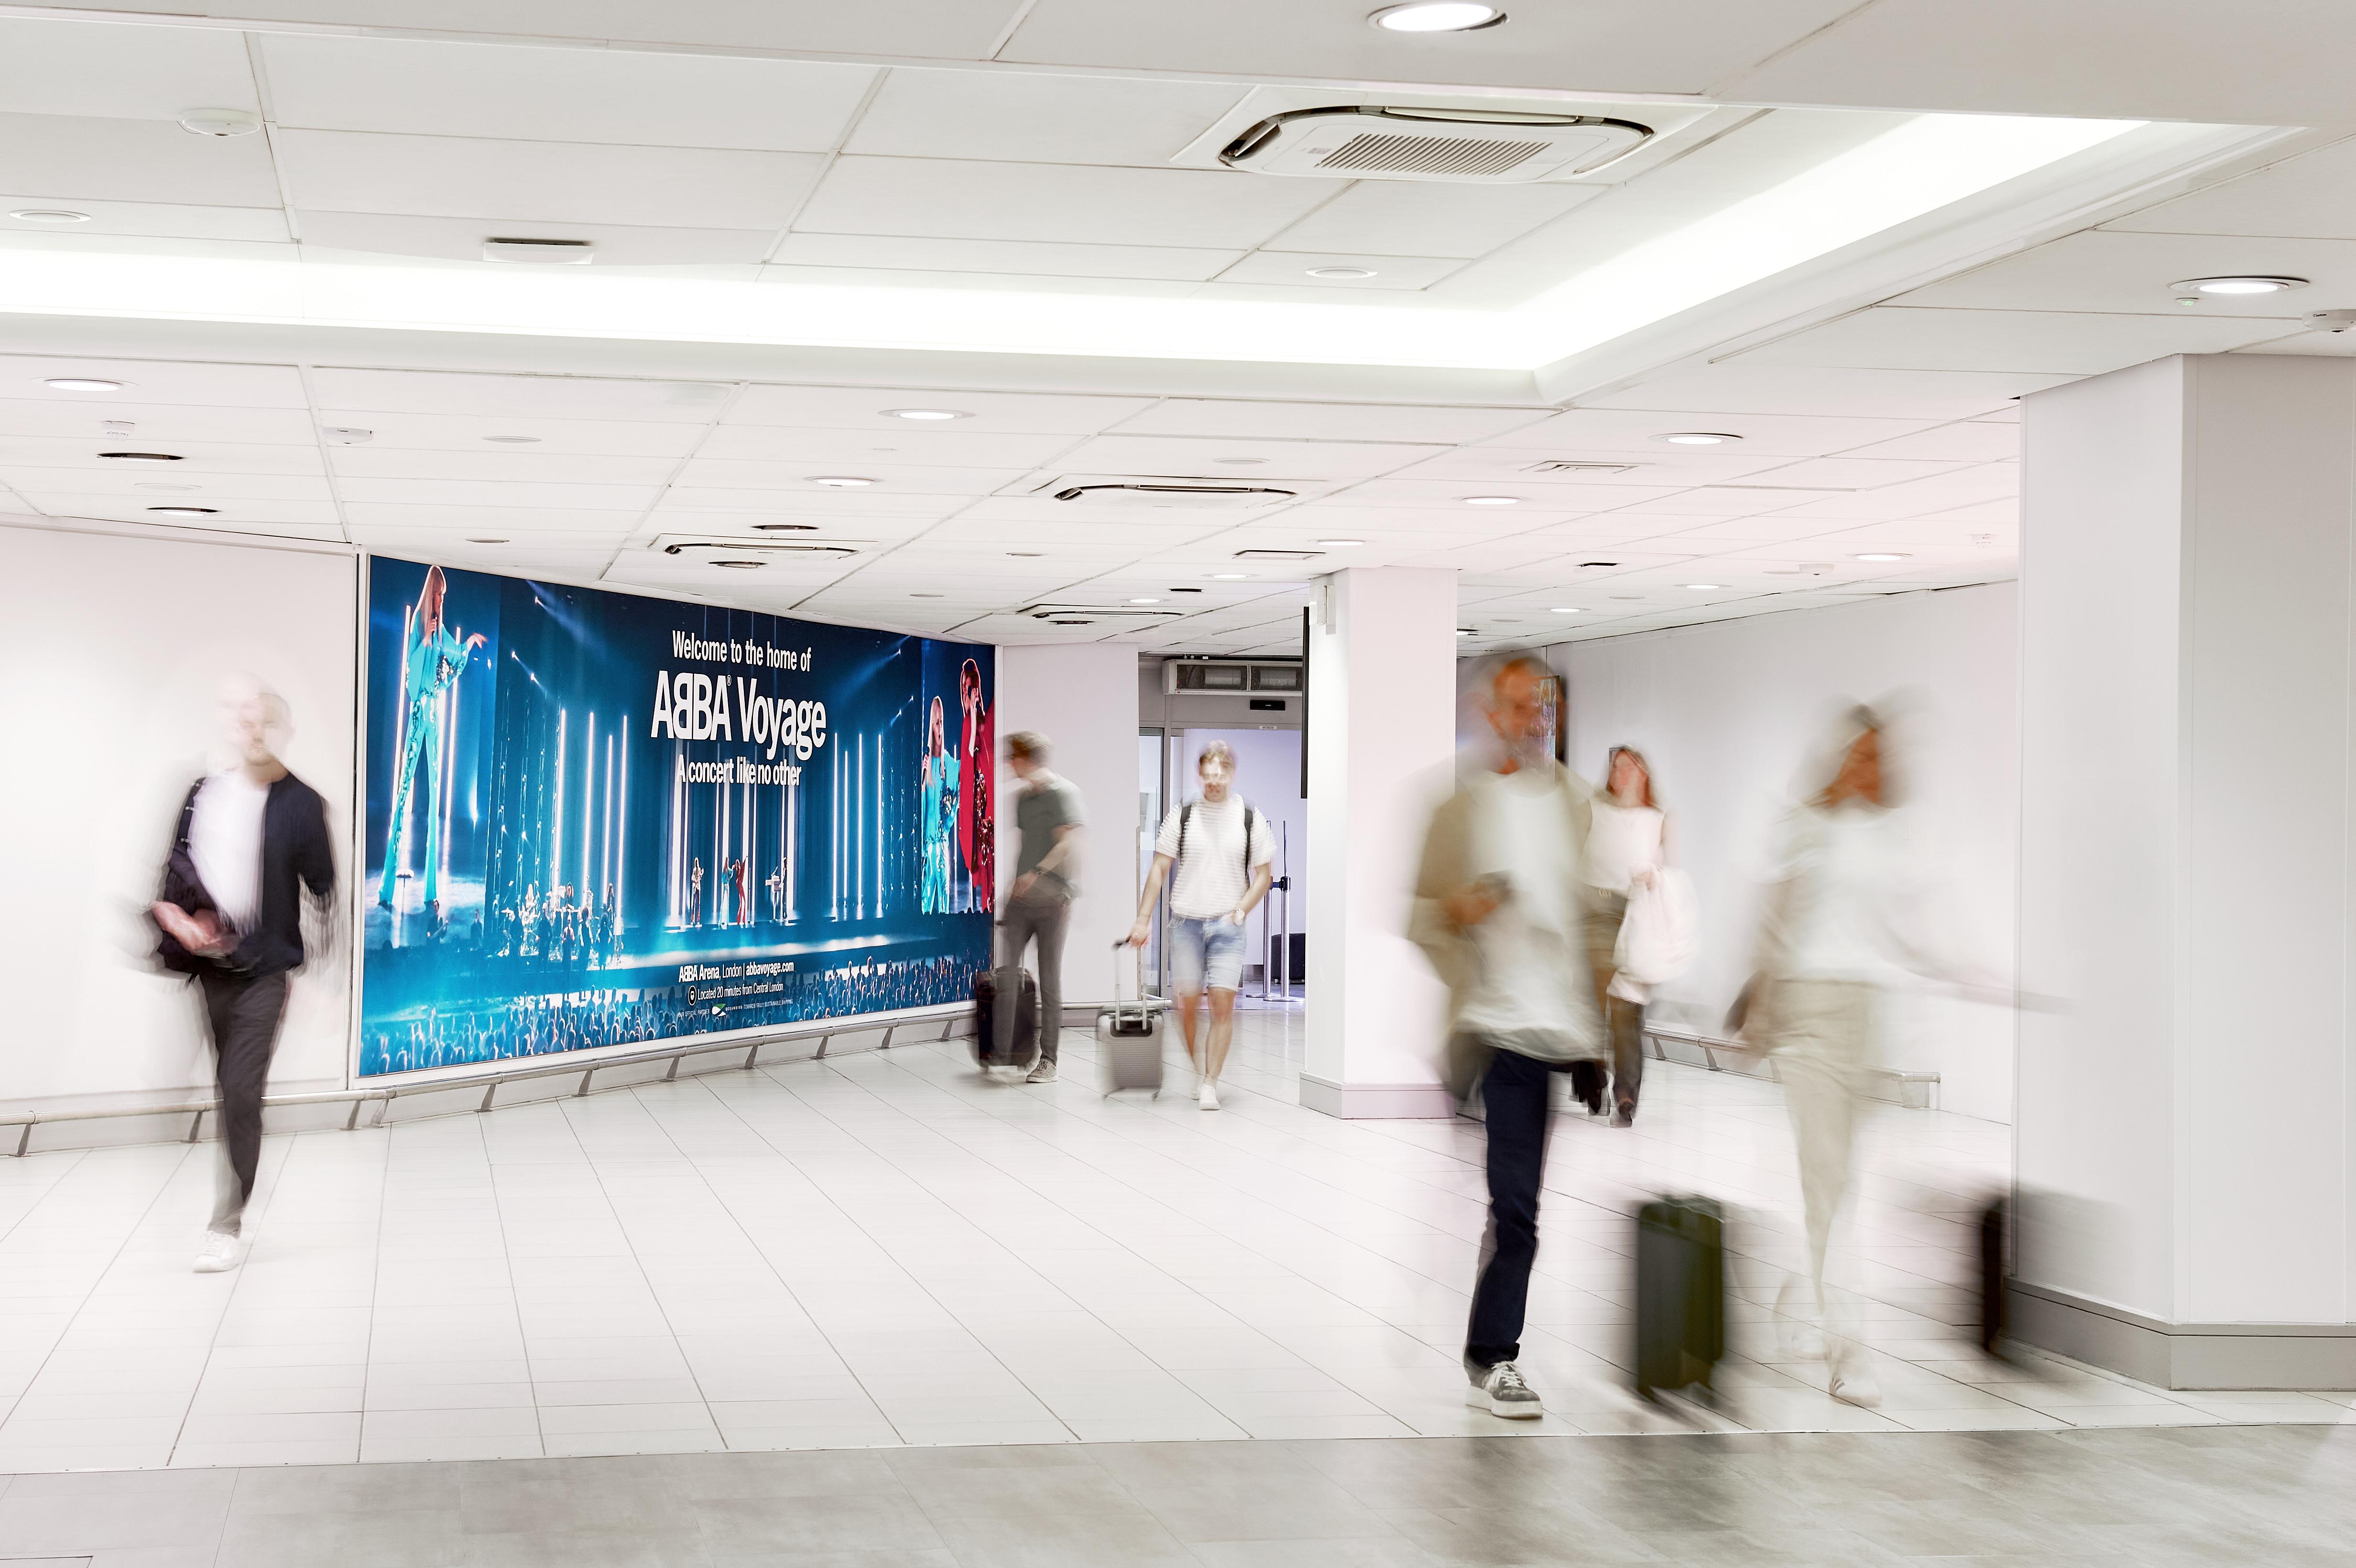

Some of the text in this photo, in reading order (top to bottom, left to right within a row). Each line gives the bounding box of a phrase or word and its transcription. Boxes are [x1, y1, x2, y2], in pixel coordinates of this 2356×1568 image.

[672, 630, 811, 672] Welcome to the home of
[737, 677, 826, 761] Voyage
[676, 754, 802, 785] A concert like no other
[679, 965, 698, 982] ABBA
[698, 964, 721, 981] Arena,
[722, 963, 742, 978] London
[746, 961, 794, 977] abbavoyage.com
[698, 981, 784, 1000] Located 20 minutes from Central London
